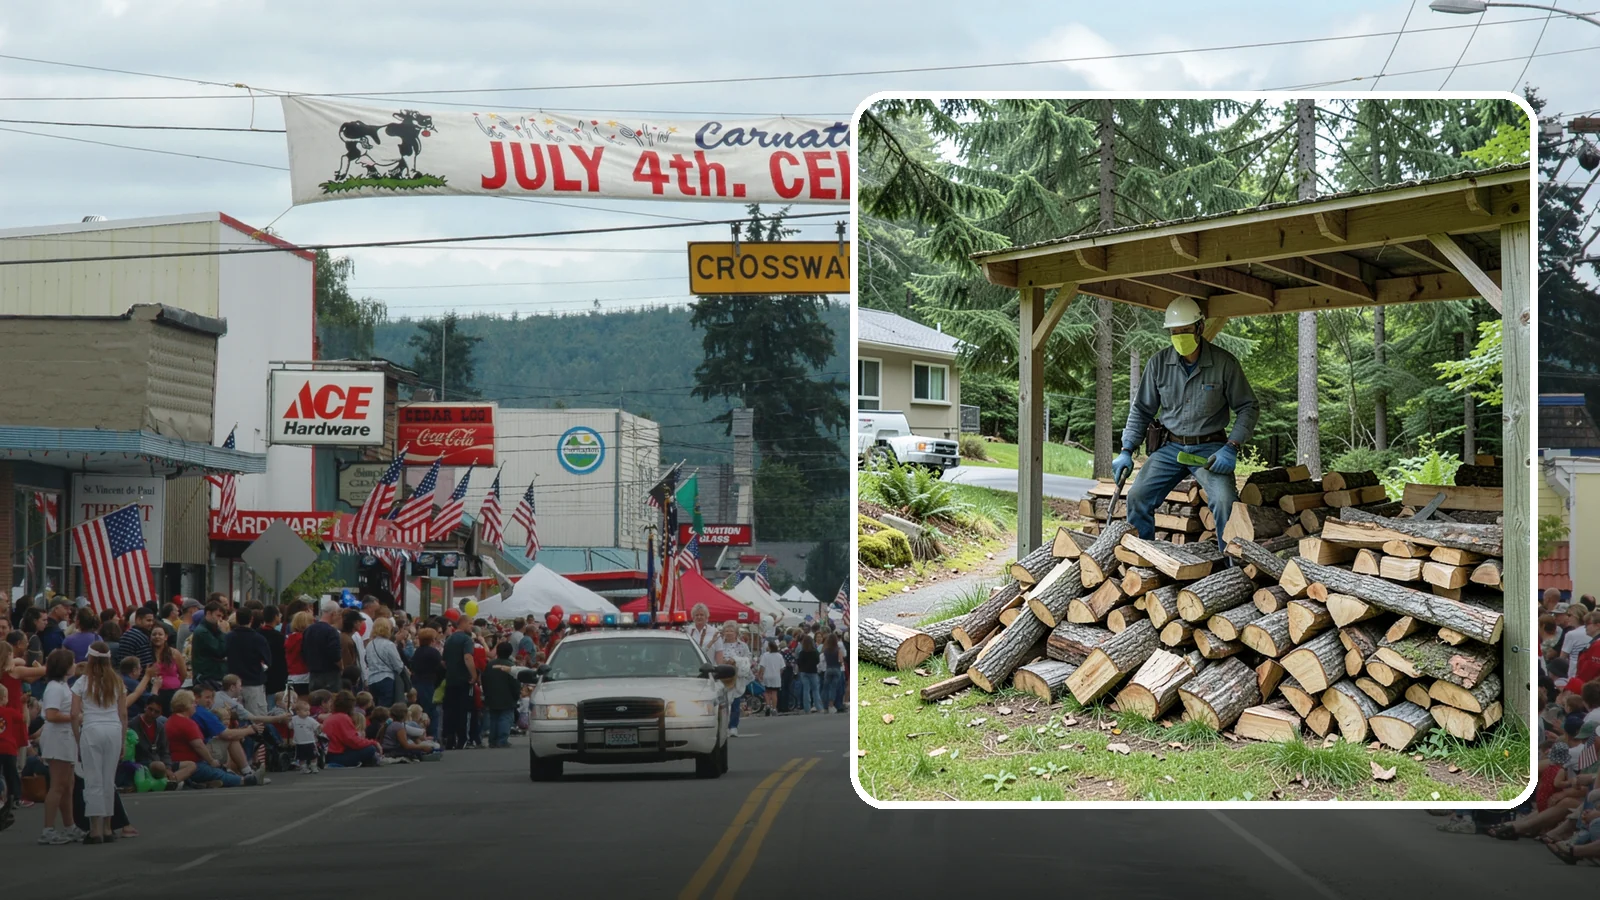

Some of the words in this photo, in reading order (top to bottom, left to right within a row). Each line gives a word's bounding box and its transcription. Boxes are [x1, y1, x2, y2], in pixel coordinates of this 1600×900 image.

[481, 141, 605, 192] JULY
[632, 150, 746, 198] 4th.
[697, 254, 850, 280] CROSSWA
[283, 380, 373, 420] ACE
[405, 409, 452, 422] CEDAR
[283, 421, 371, 436] Hardware
[416, 428, 477, 447] Coca-Cola
[83, 484, 94, 495] St.
[95, 485, 125, 495] Vincent
[126, 486, 136, 495] de
[137, 485, 155, 496] Paul
[81, 503, 154, 522] THT
[688, 526, 742, 536] CRNATION
[699, 535, 731, 544] GLASS
